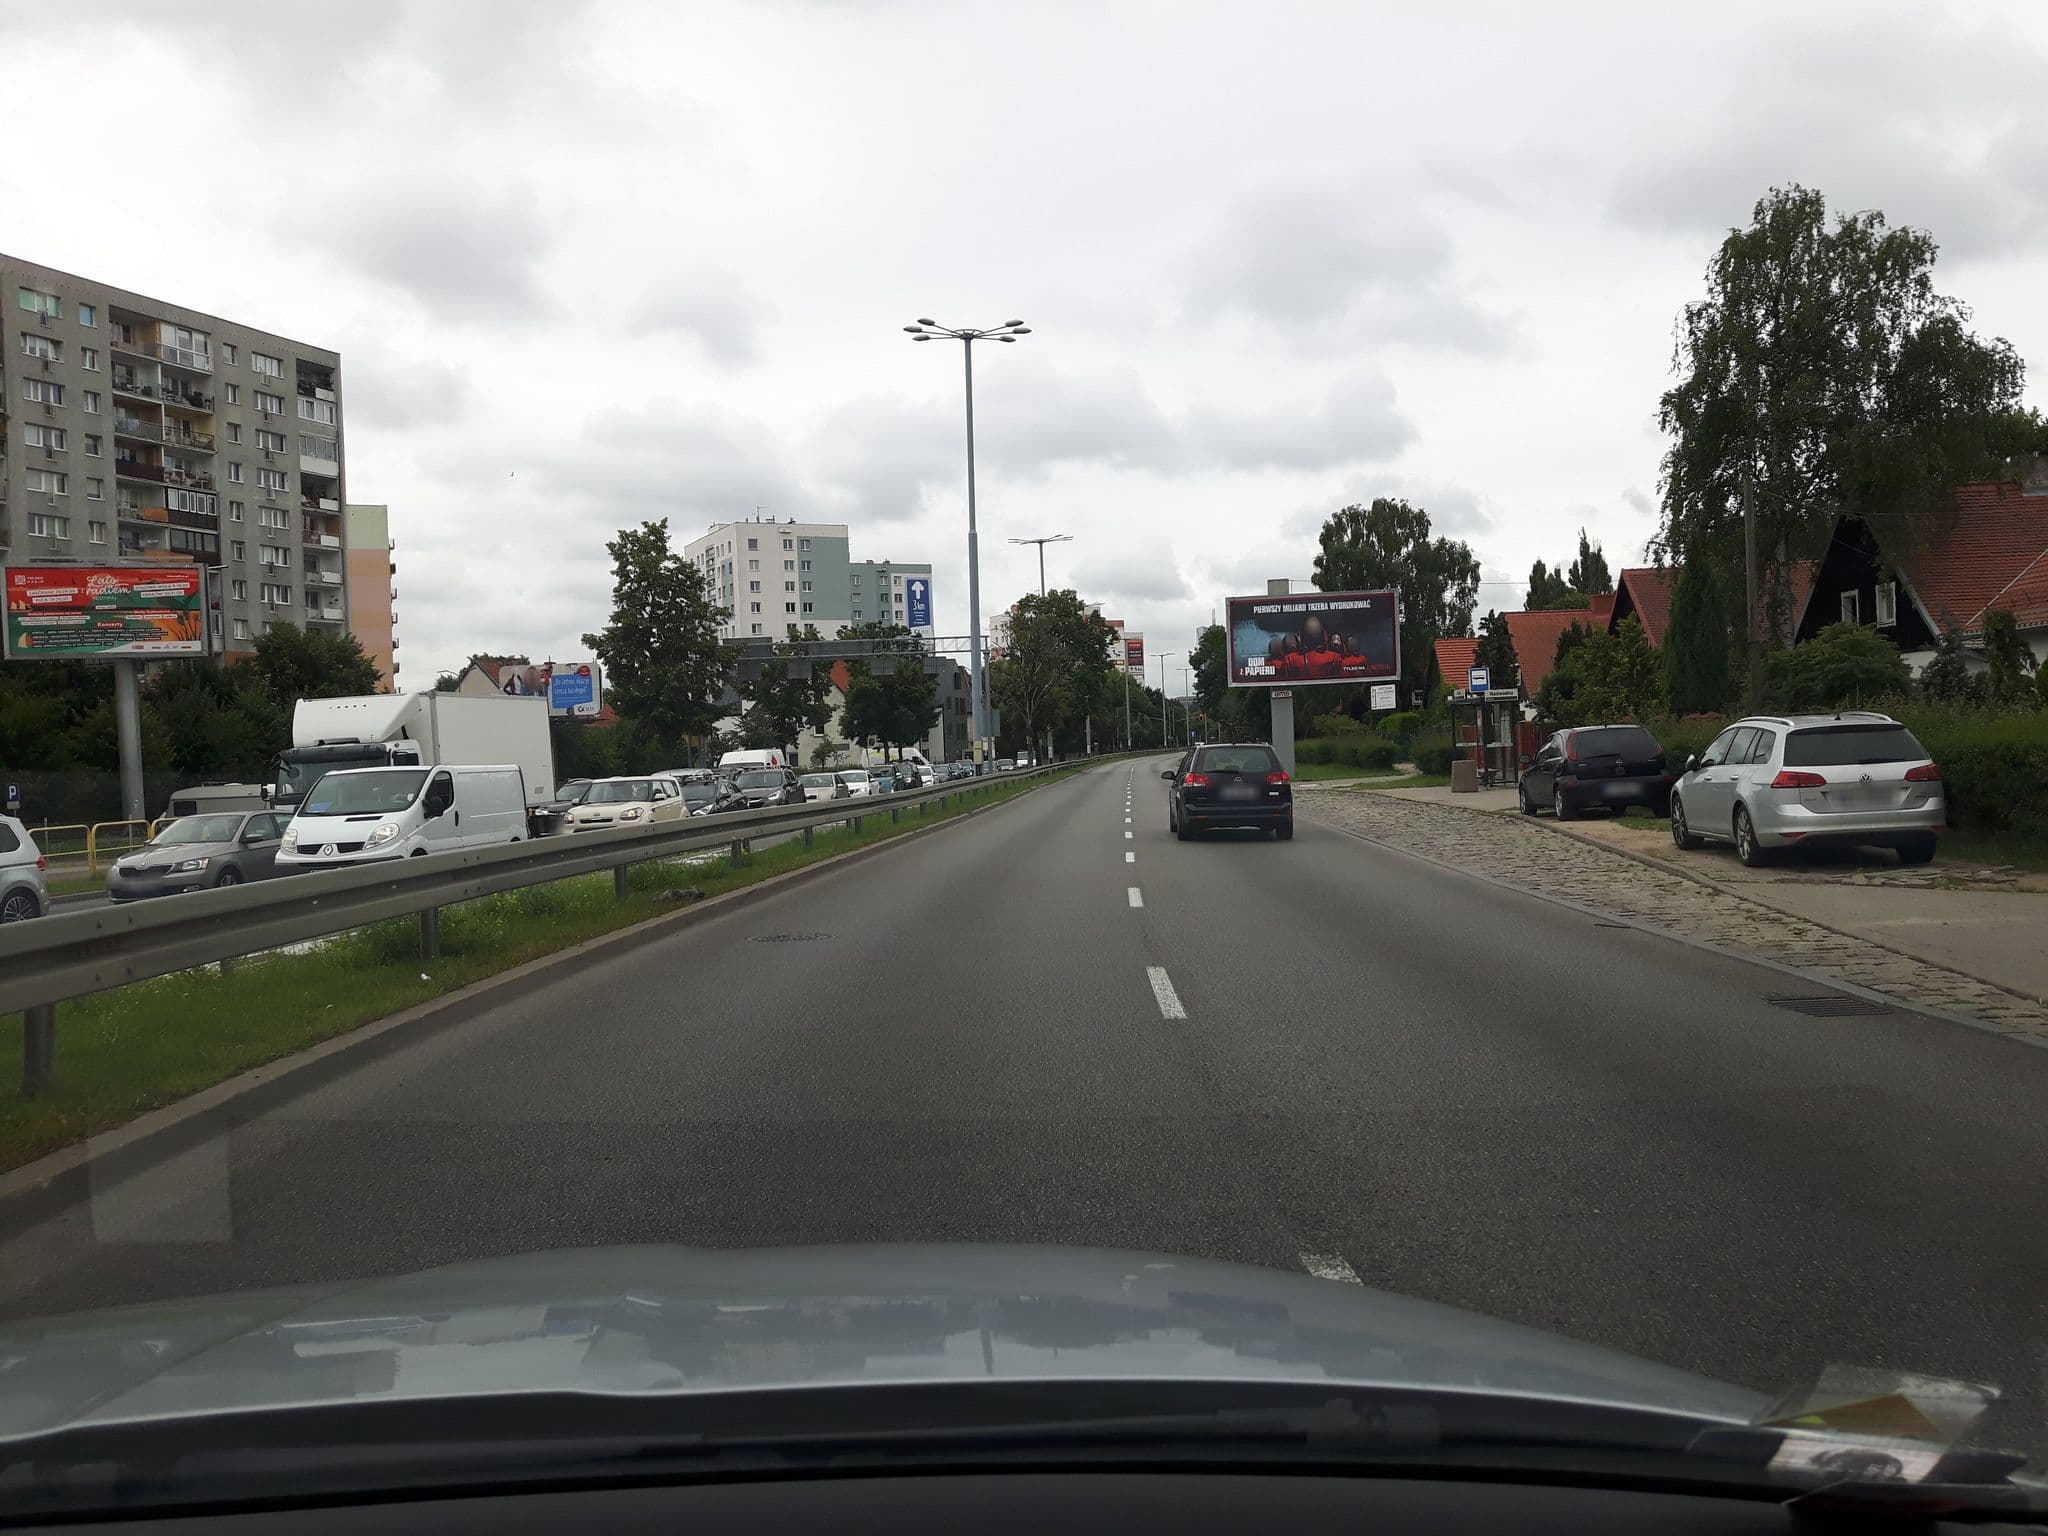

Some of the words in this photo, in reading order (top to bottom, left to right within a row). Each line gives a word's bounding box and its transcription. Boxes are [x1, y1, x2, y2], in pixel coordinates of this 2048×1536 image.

[86, 575, 118, 587] Lato
[86, 584, 131, 595] radiem
[1253, 605, 1282, 614] PIERWSZY
[1283, 603, 1307, 613] MILIARD
[1308, 602, 1329, 611] TRZEBA
[1330, 600, 1371, 609] WYDRUKOWAĆ
[1248, 657, 1265, 667] DOM
[1245, 666, 1276, 676] PAPIERU
[9, 785, 17, 800] P
